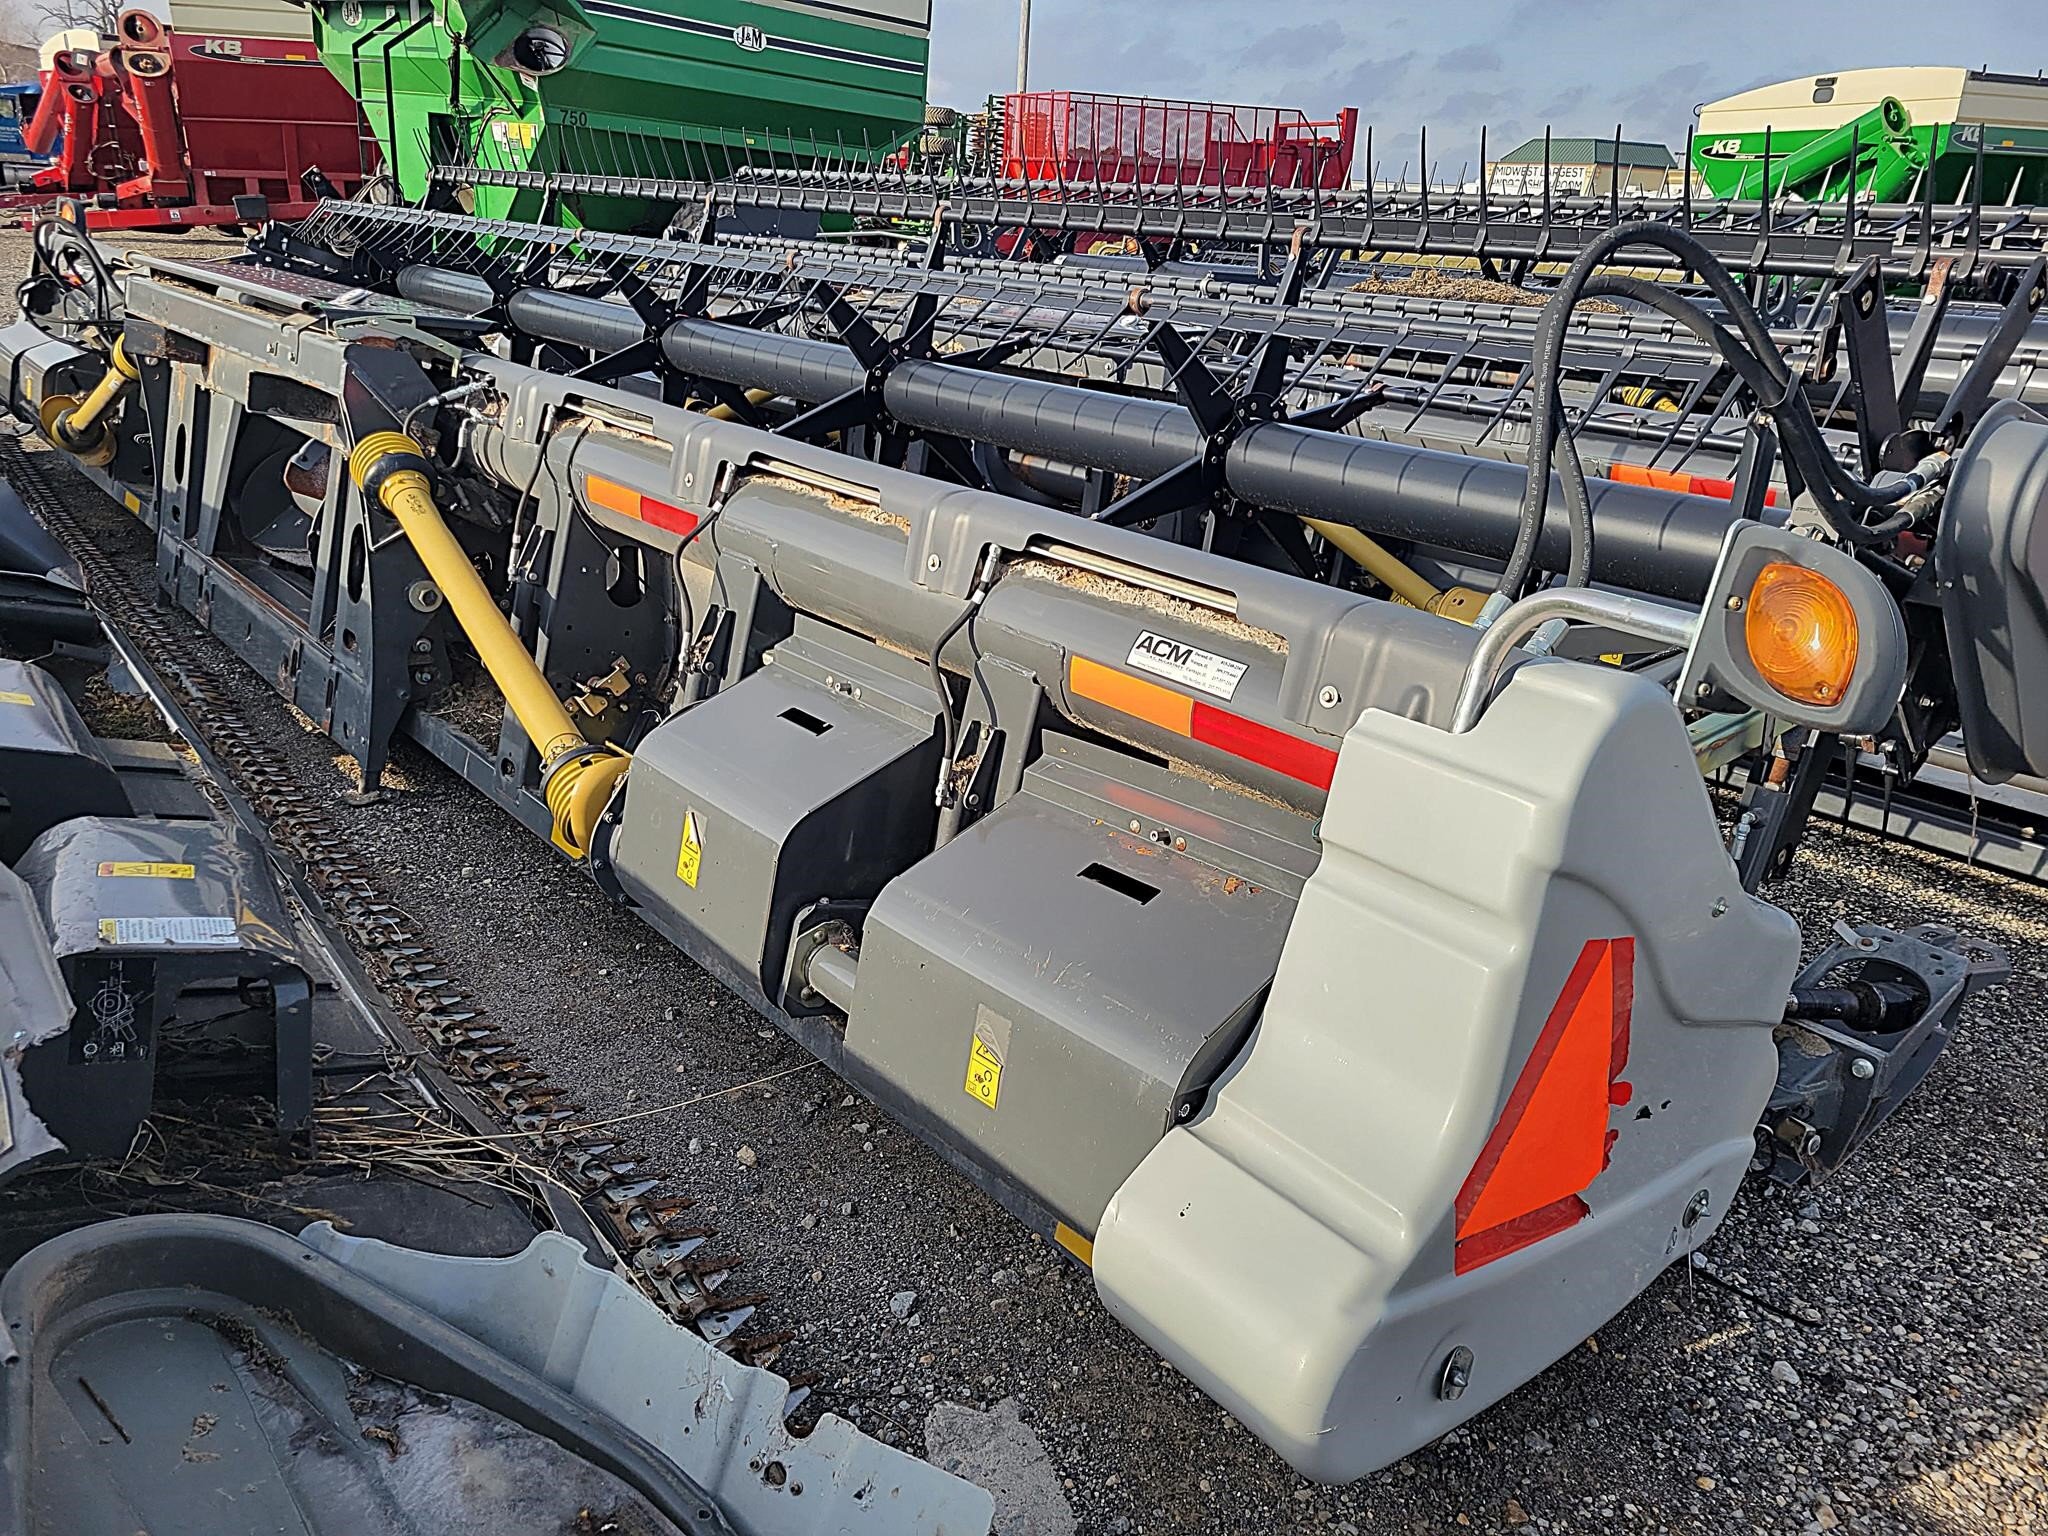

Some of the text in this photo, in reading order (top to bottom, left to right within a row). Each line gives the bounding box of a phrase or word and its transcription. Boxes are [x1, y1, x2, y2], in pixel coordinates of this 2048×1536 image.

[736, 26, 763, 49] J&M
[204, 39, 242, 55] KB
[559, 110, 588, 127] 750
[1710, 139, 1742, 155] KB
[1495, 166, 1539, 177] MIDWEST
[1532, 462, 1540, 477] 3000
[1136, 635, 1194, 665] ACM
